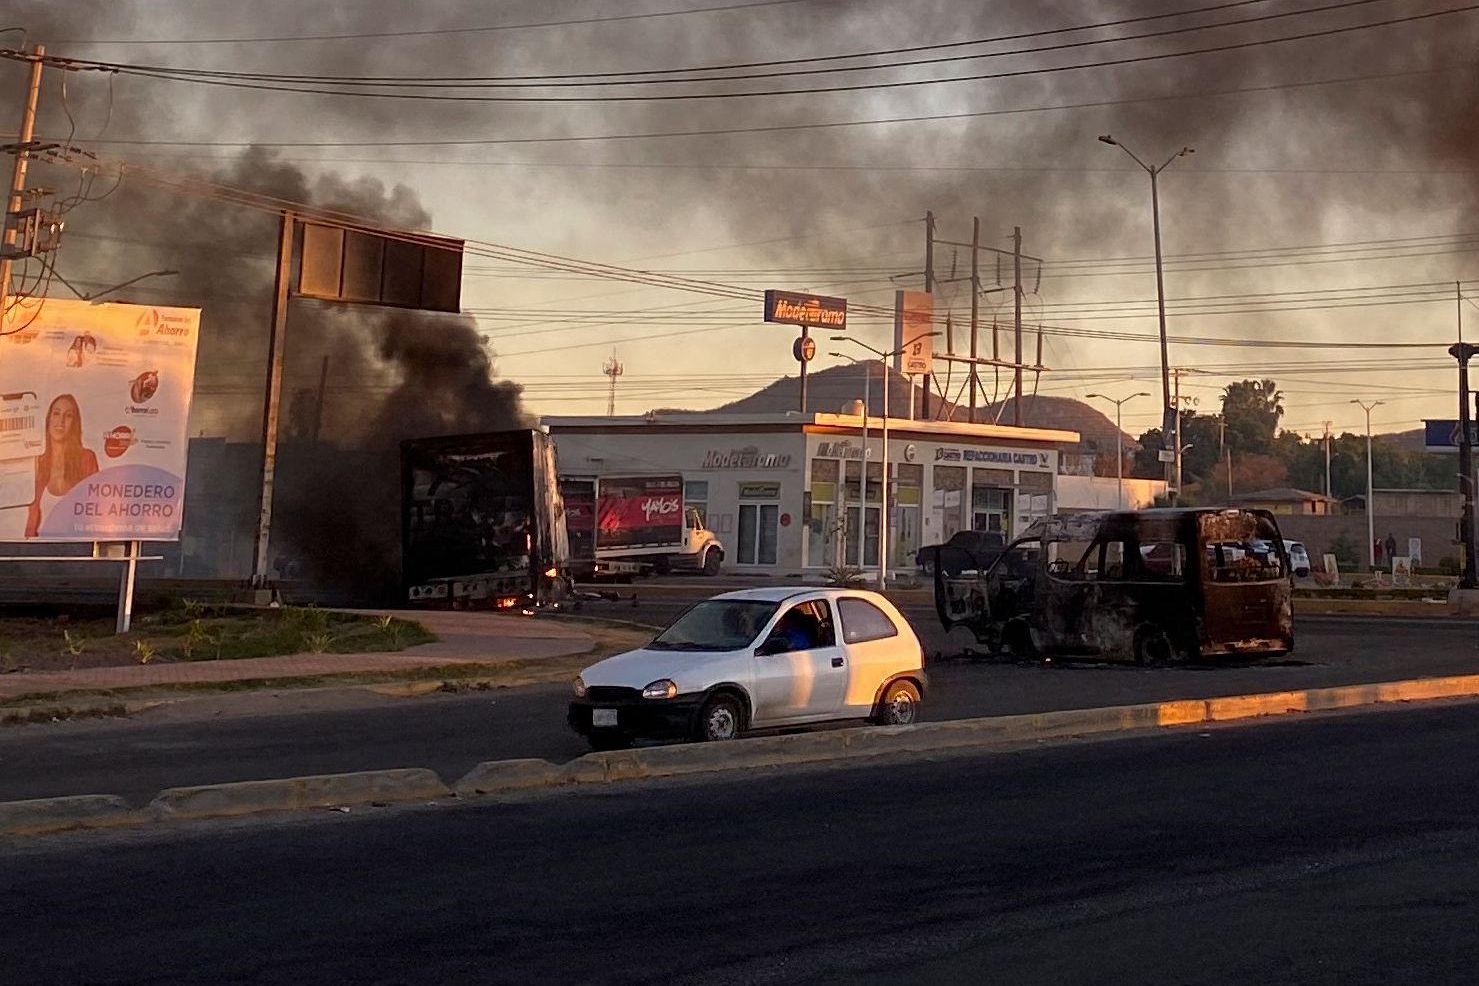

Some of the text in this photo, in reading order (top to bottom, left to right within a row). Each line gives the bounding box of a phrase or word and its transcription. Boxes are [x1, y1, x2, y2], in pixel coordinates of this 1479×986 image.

[702, 449, 792, 469] Modelrama
[88, 483, 175, 499] MONEDERO
[74, 502, 174, 517] DEL AHORRO
